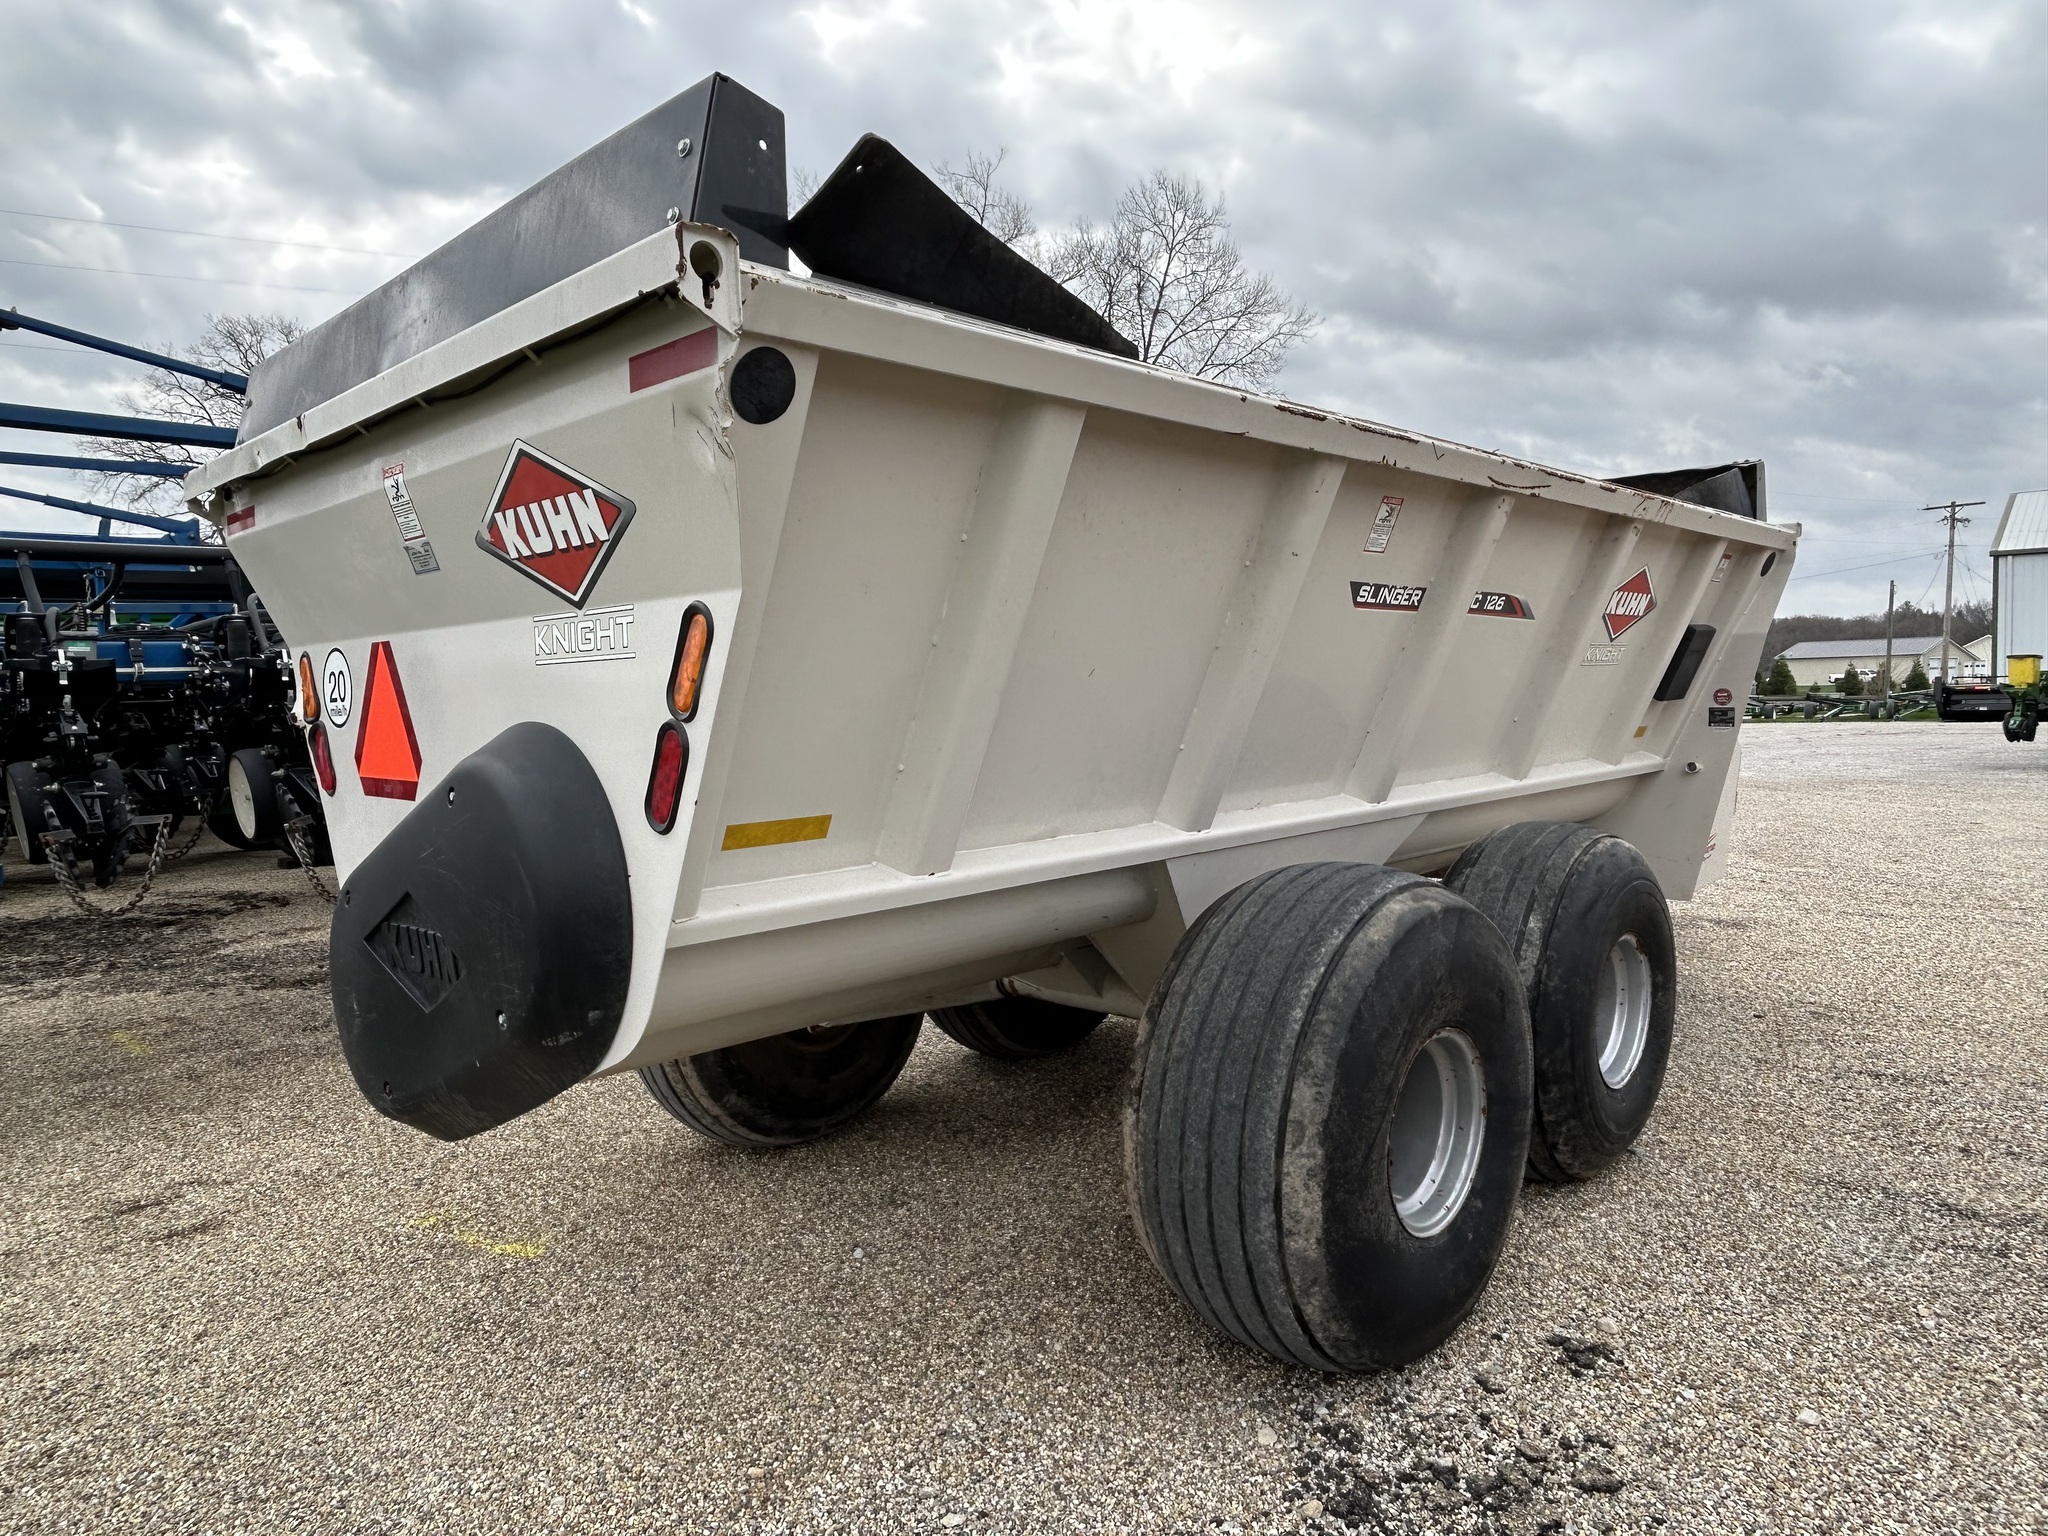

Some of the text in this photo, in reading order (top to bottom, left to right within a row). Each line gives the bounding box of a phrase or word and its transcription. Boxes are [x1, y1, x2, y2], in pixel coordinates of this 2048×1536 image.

[494, 488, 609, 559] KUHN
[1356, 585, 1423, 606] SLINGER
[1483, 595, 1505, 610] 126
[1605, 590, 1651, 616] KUHN
[533, 614, 635, 656] KNIGHT
[1585, 647, 1626, 661] KNIGHT
[328, 670, 346, 703] 20
[381, 922, 460, 984] KUHN
